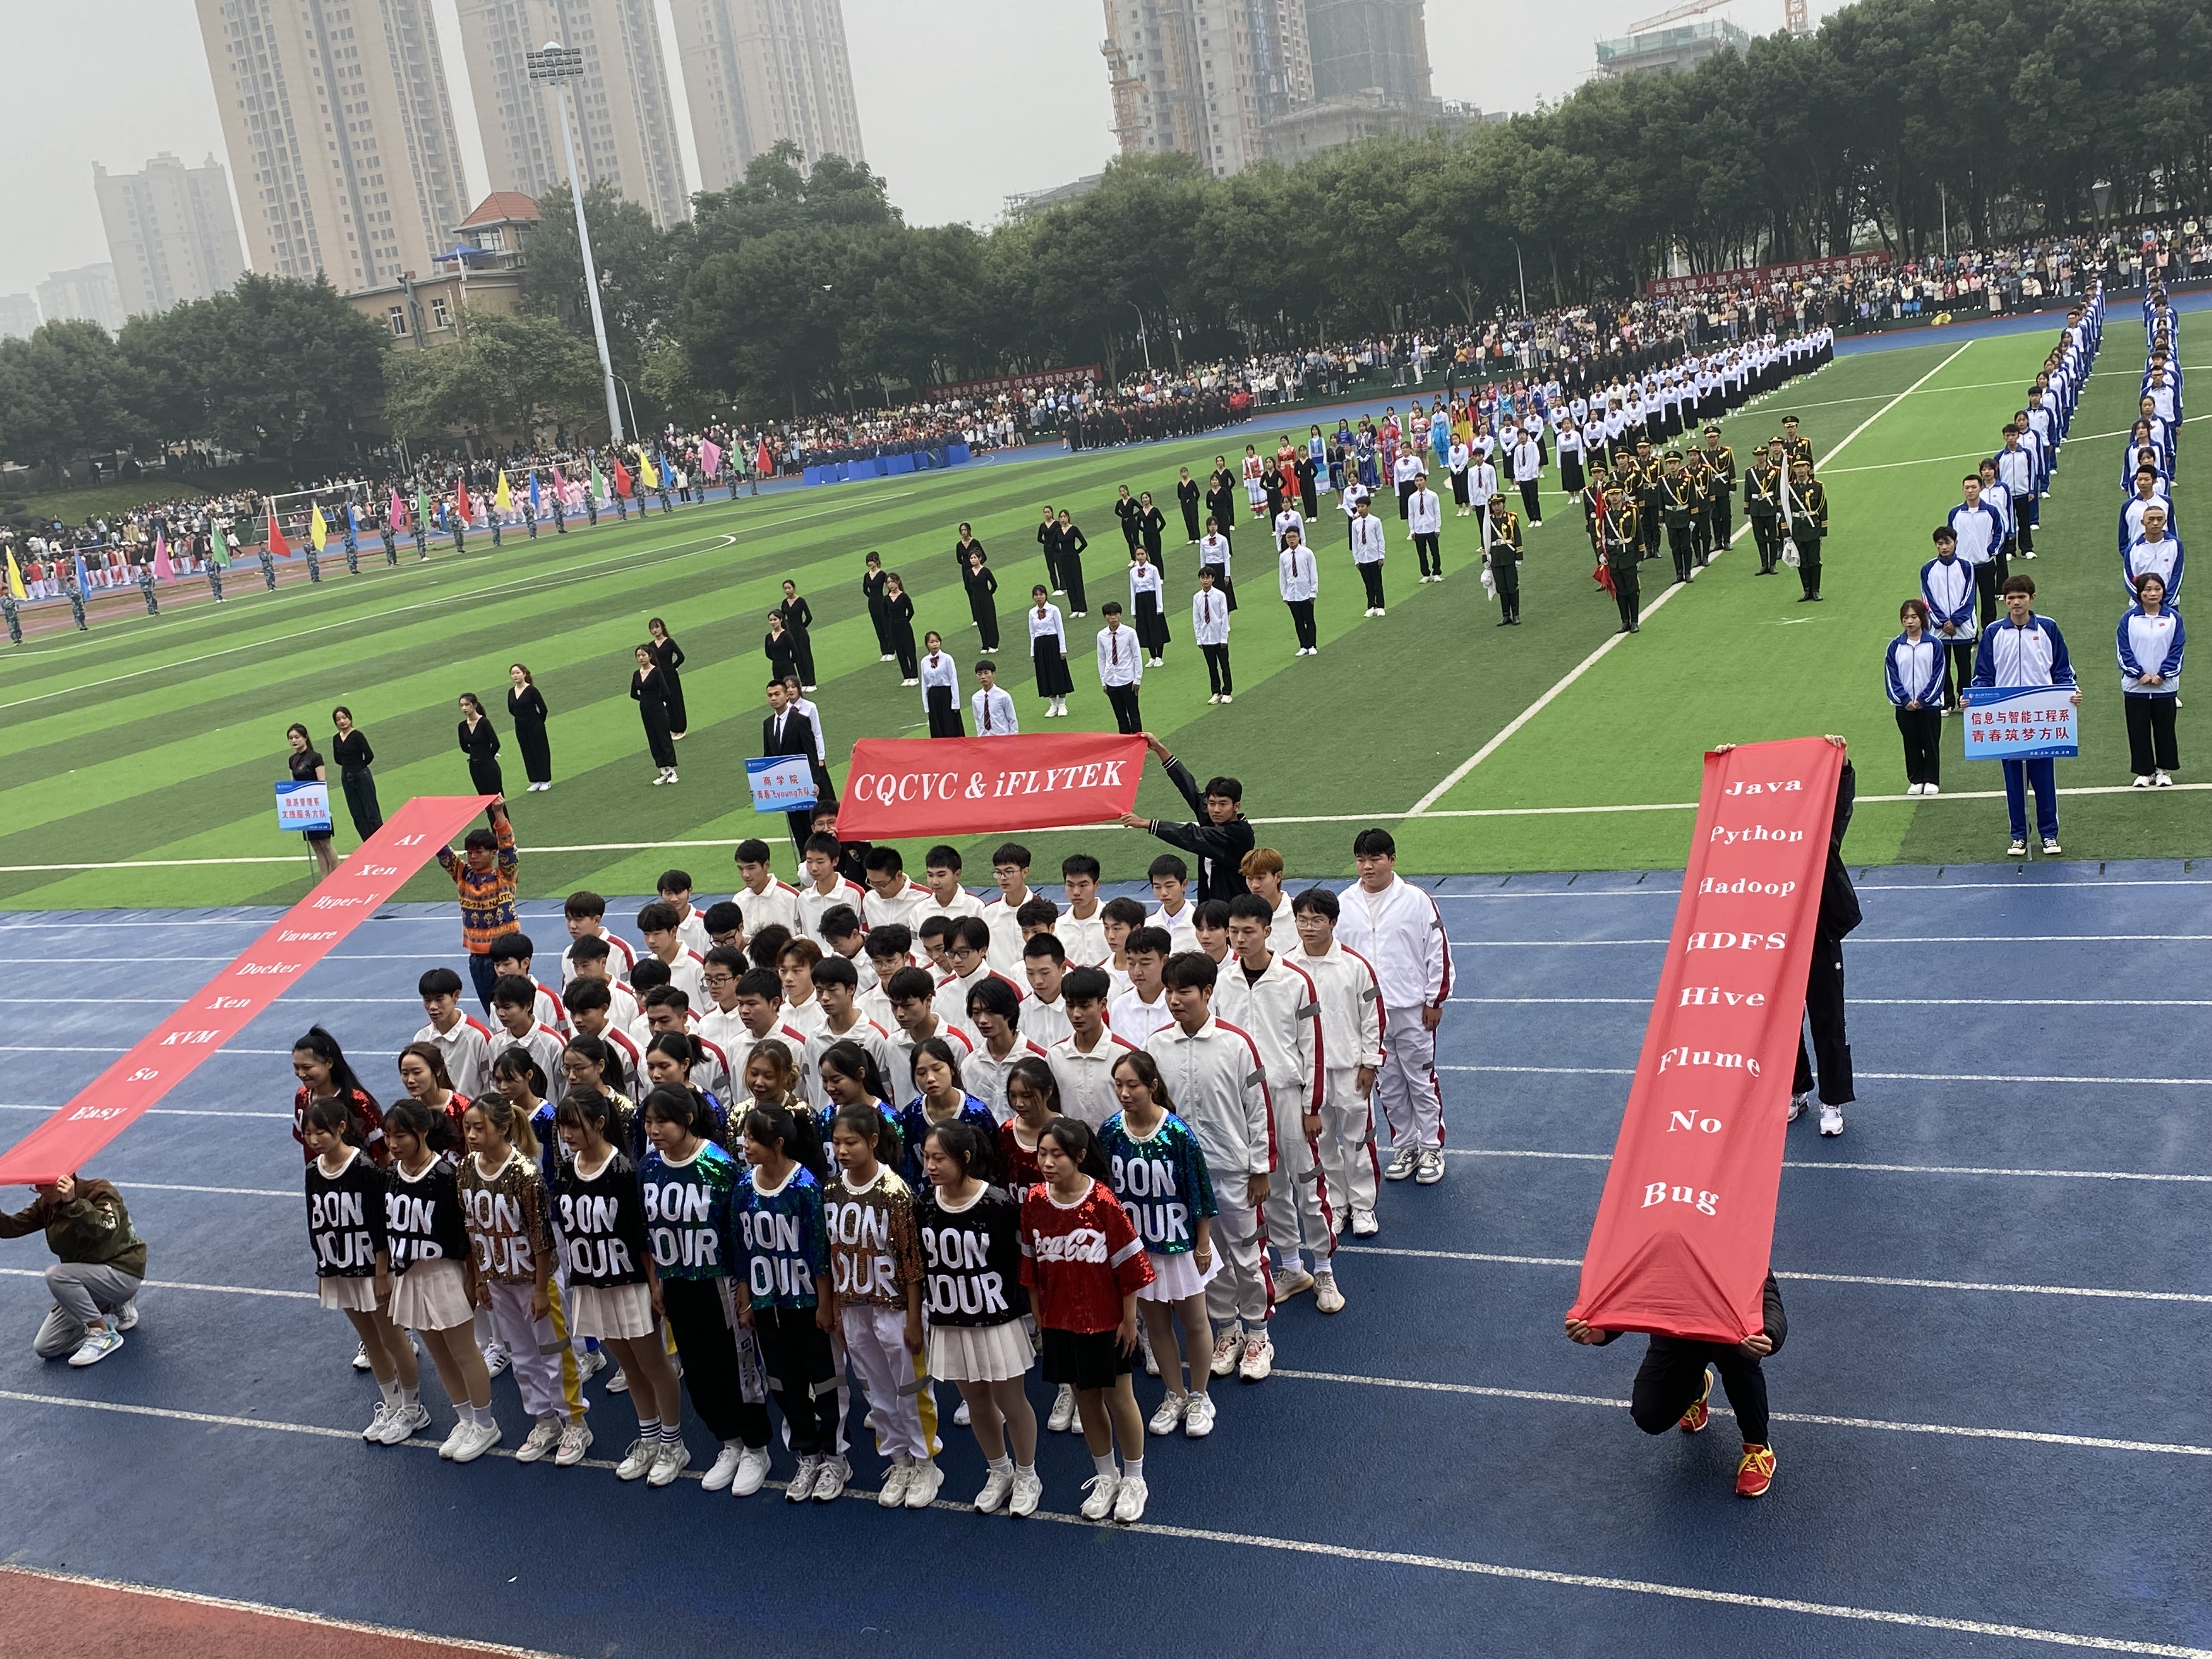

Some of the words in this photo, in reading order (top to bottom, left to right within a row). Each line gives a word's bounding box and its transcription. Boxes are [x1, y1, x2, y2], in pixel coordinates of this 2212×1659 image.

[1655, 271, 1759, 294] 运动健儿显身手
[1014, 369, 1095, 387] 促进学校和谐发展
[1972, 709, 2070, 725] 信息与智能工程系
[1972, 726, 2070, 743] 青春筑梦方队
[763, 775, 799, 786] 商学院
[854, 771, 958, 806] CQCVC
[964, 771, 988, 799] &
[992, 760, 1127, 797] iFLYTEK
[1725, 780, 1803, 797] Java
[286, 798, 319, 806] 旅游管理系
[281, 809, 327, 819] 文旅服务方队
[393, 833, 427, 846] AI
[1709, 825, 1804, 845] Python
[354, 864, 398, 876] Xen
[1698, 877, 1796, 898] Hadoop
[312, 893, 380, 910] Hyper-V
[276, 930, 338, 942] Vmware
[1685, 931, 1787, 954] HDFS
[235, 961, 302, 975] Docker
[205, 996, 251, 1009] Xen
[1678, 986, 1765, 1008] Hive
[159, 1029, 221, 1046] KVM
[1657, 1046, 1761, 1078] Flume
[126, 1067, 159, 1082] So
[67, 1106, 128, 1121] Easy
[1666, 1109, 1722, 1134] No
[1111, 1155, 1176, 1197] BON
[644, 1182, 712, 1223] BON
[1640, 1182, 1720, 1217] Bug
[312, 1191, 364, 1229] BON
[385, 1192, 436, 1234] BON
[462, 1188, 520, 1233] BON
[560, 1194, 618, 1233] BON
[739, 1210, 800, 1252] BON
[823, 1201, 889, 1250] BON
[921, 1227, 990, 1269] BON
